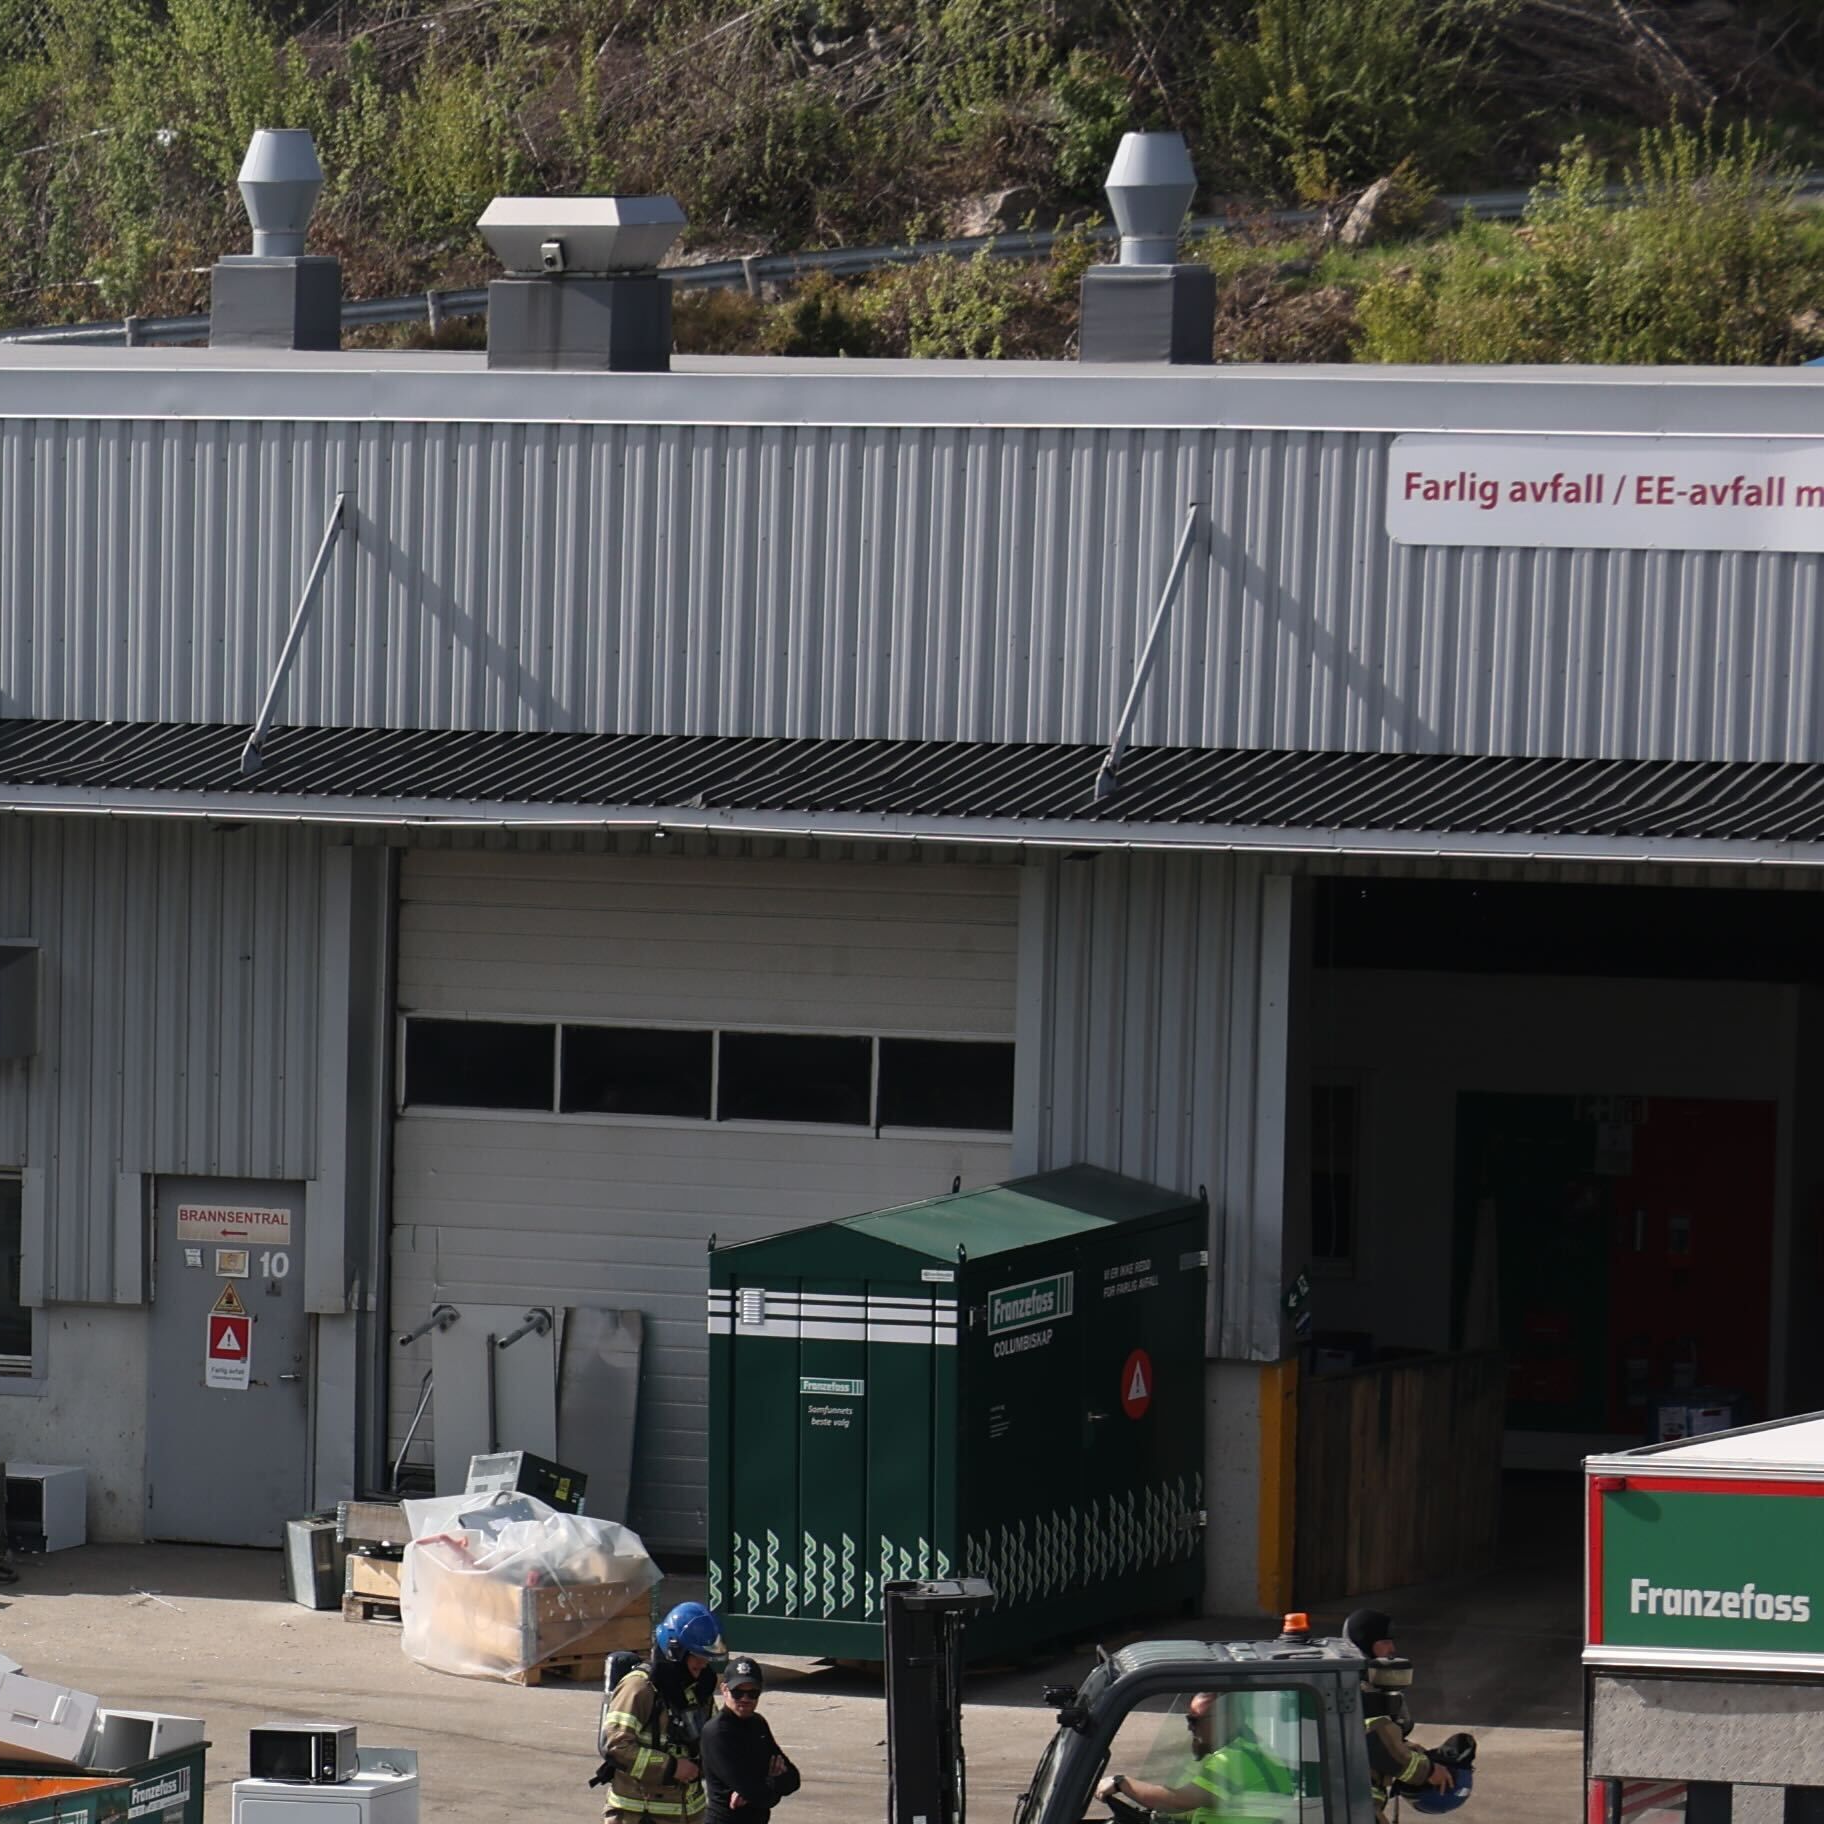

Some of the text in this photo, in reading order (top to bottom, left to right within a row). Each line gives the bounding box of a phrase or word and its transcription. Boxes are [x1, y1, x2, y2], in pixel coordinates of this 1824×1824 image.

[1404, 472, 1499, 510] Farlig
[1509, 473, 1604, 505] avfall
[1612, 475, 1626, 506] /
[1635, 474, 1785, 507] EE-avfall
[179, 1209, 289, 1226] BRANNSENTRAL
[259, 1251, 290, 1278] 10
[993, 1288, 1054, 1326] Franzefoss
[993, 1328, 1053, 1358] COLUMBISKAP
[802, 1380, 850, 1392] Franzefoss
[1629, 1577, 1811, 1624] Franzefoss
[131, 1778, 177, 1804] Franzefoss
